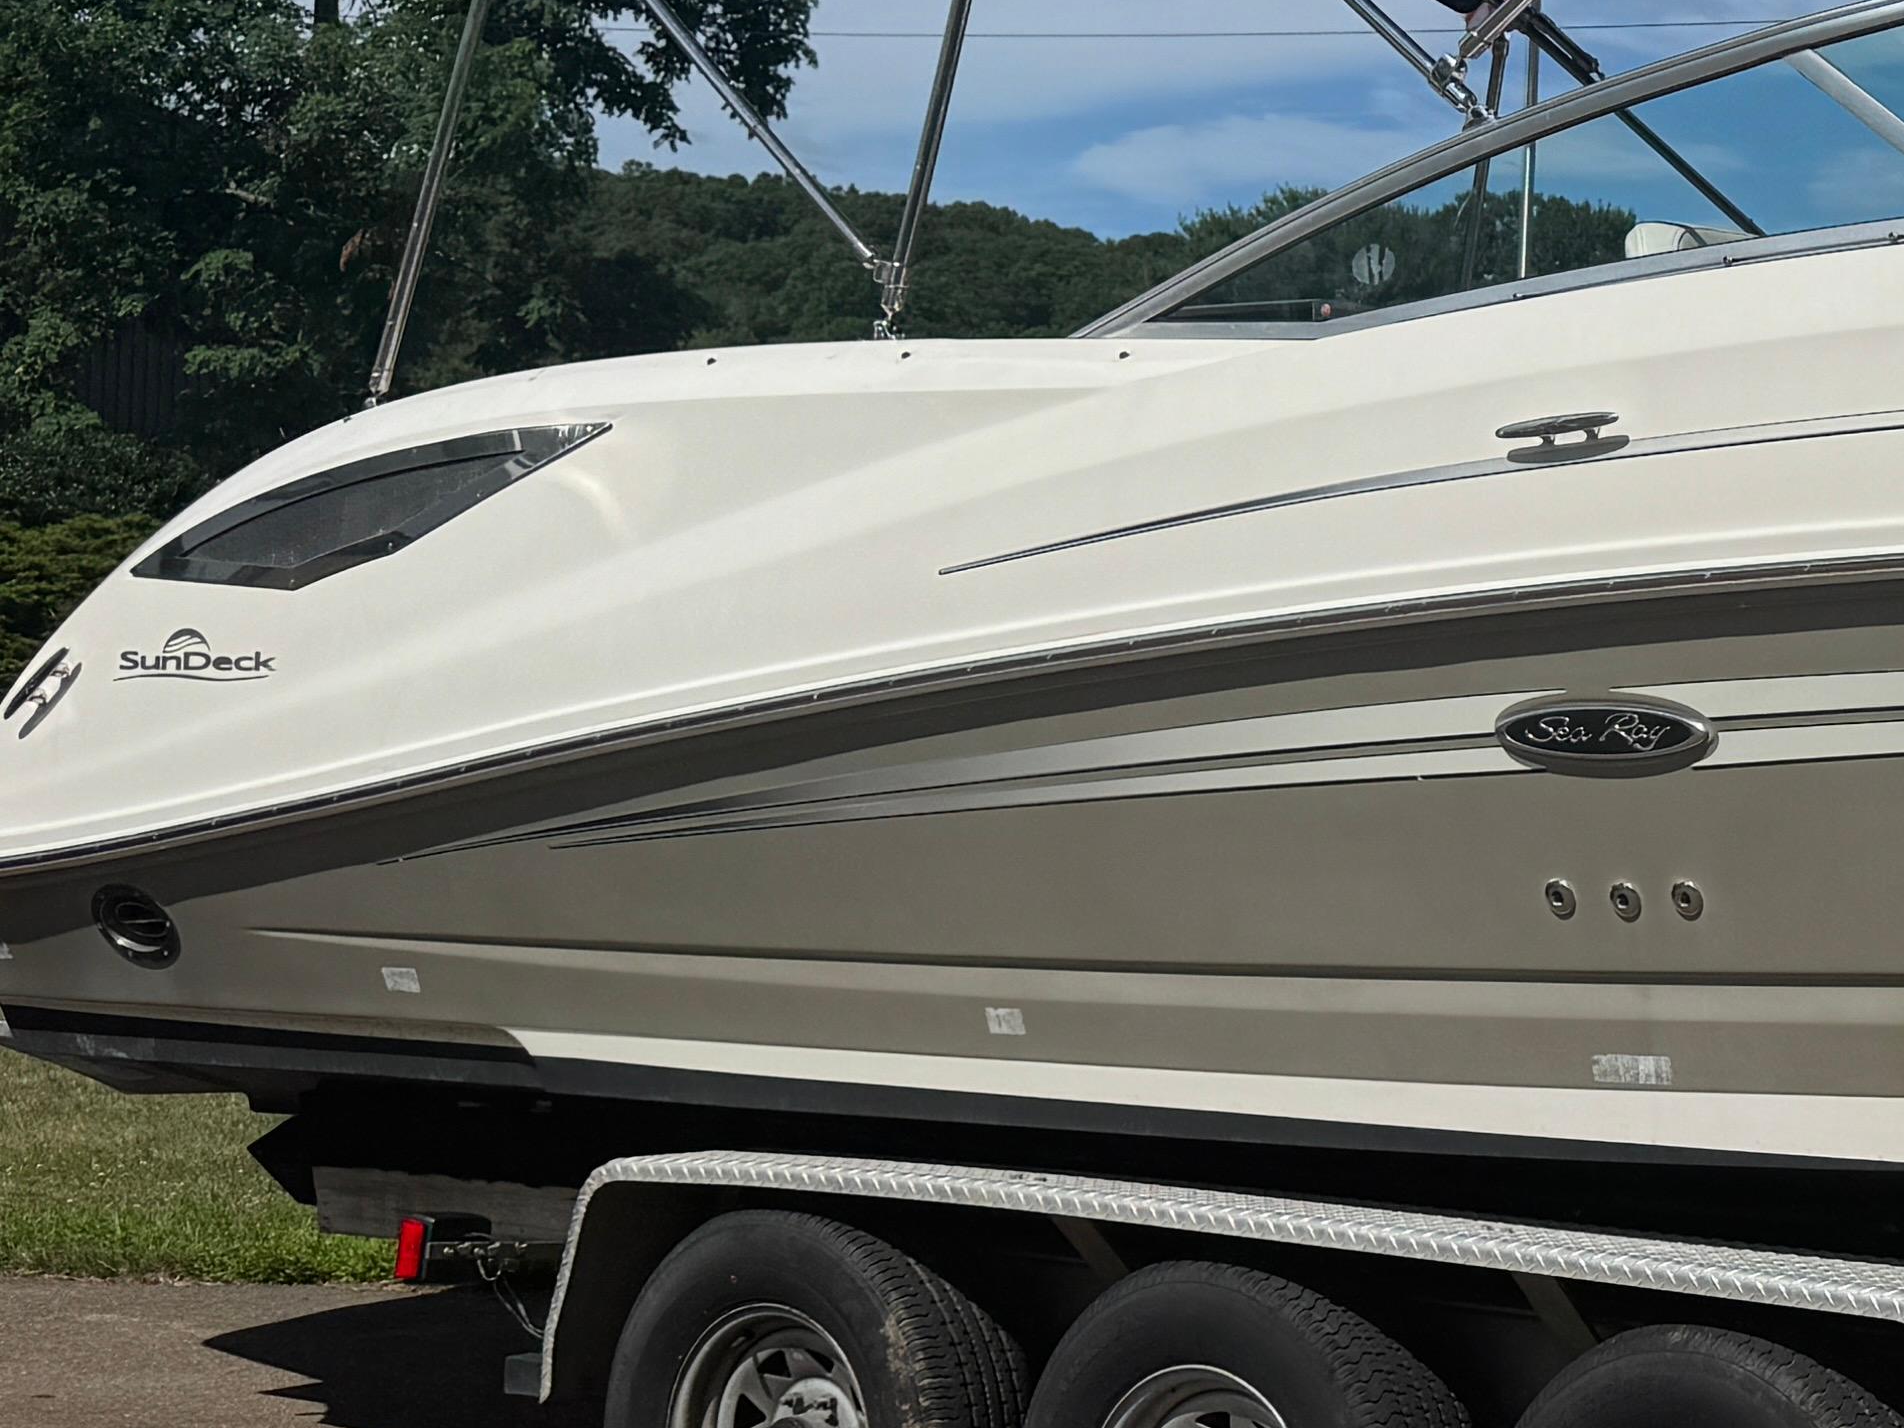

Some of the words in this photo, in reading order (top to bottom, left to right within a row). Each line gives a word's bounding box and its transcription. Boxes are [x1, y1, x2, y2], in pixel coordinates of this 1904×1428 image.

[118, 651, 277, 671] SunDeck
[1525, 715, 1592, 743] Sea
[1599, 712, 1671, 750] Ray
